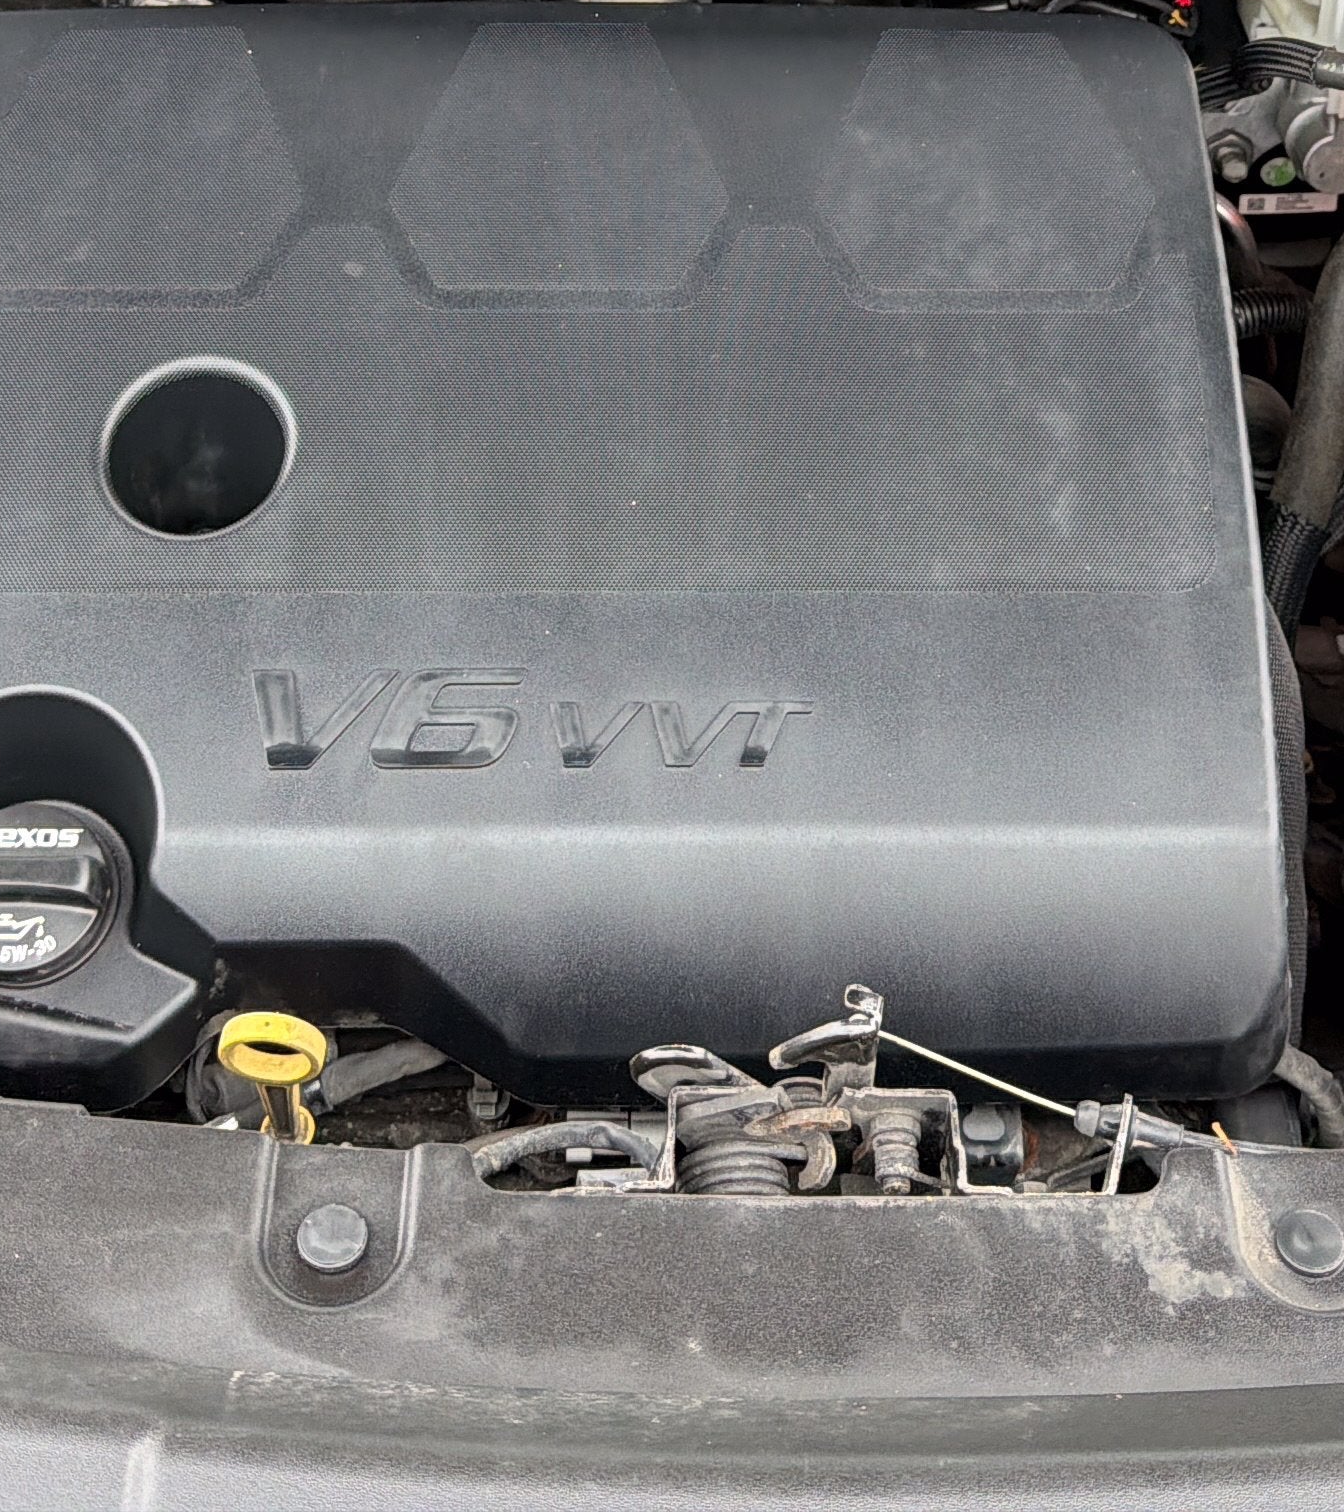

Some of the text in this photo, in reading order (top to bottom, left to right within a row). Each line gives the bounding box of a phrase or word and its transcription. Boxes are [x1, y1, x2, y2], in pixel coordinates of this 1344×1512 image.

[253, 668, 814, 770] V6 VVT
[0, 934, 57, 965] 5W-30
